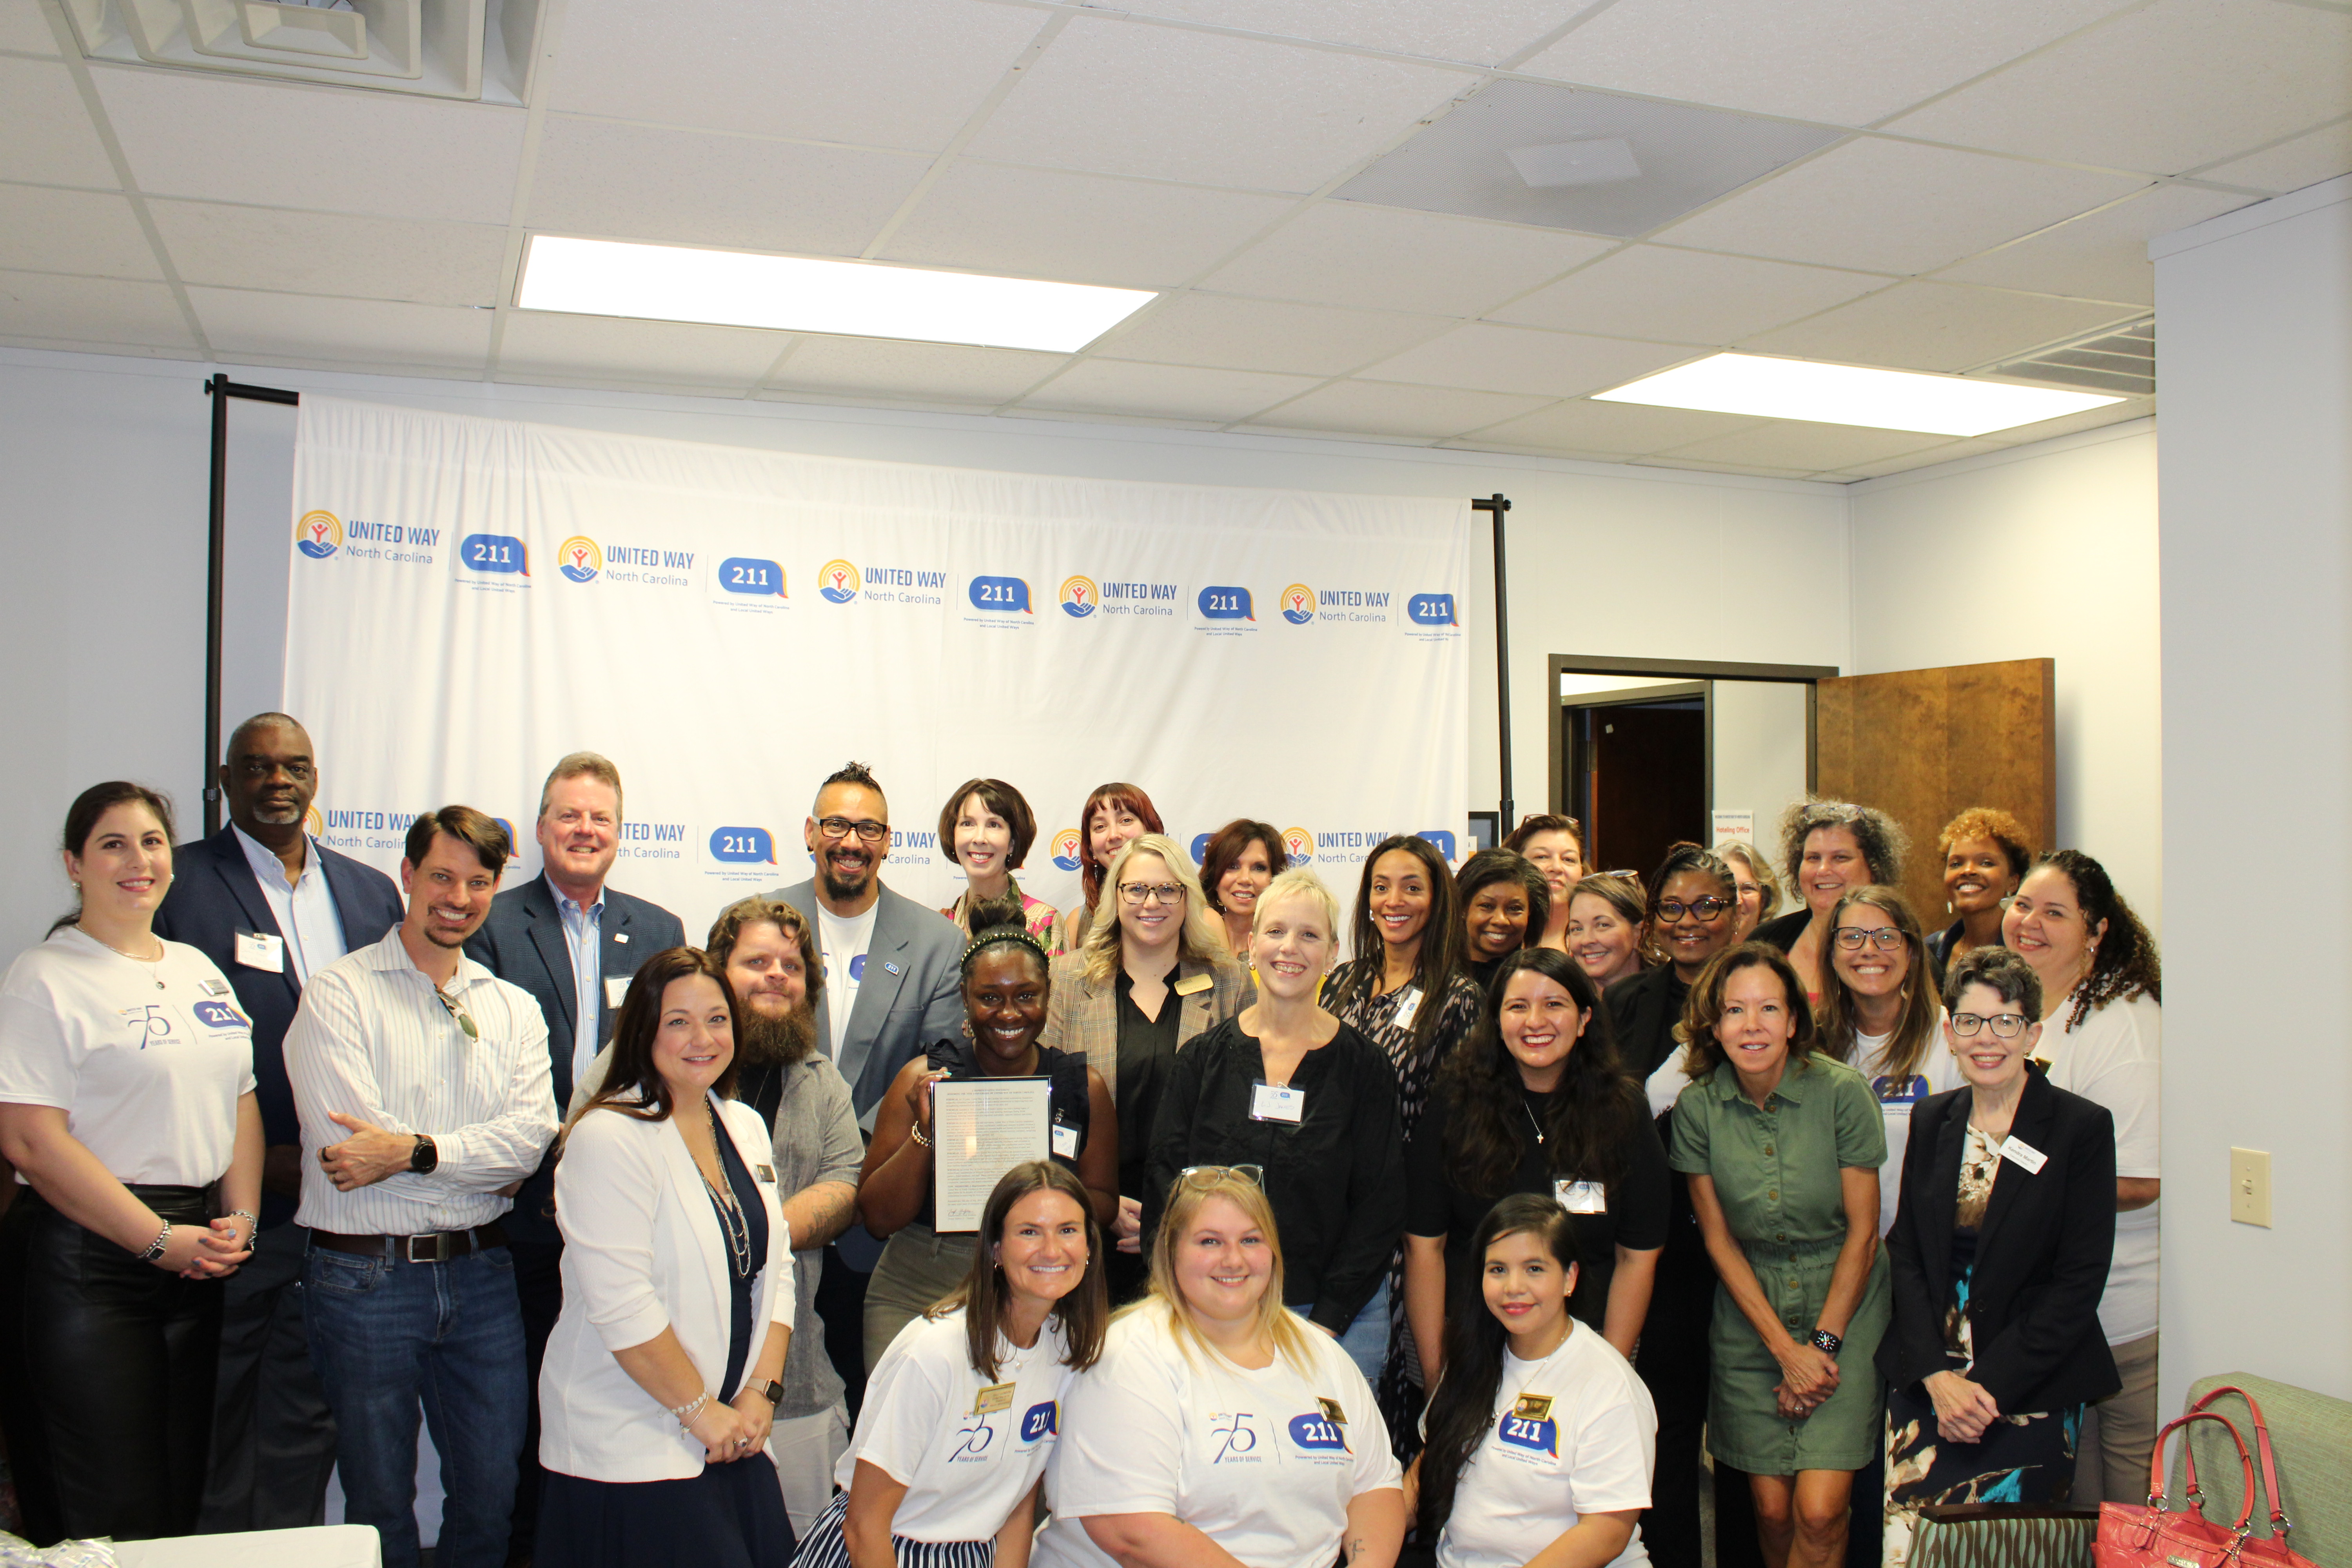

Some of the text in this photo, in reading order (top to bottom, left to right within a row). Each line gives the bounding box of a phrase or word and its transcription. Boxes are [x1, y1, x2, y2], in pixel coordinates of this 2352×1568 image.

[348, 520, 440, 546] UNITED WAY
[346, 545, 433, 564] North Carolina
[473, 543, 511, 563] 211
[607, 545, 695, 570] UNITED WAY
[606, 569, 688, 586] North Carolina
[732, 566, 768, 586] 211
[865, 567, 946, 588] UNITED WAY
[865, 590, 941, 605] North Carolina
[980, 584, 1014, 603] 211
[1103, 582, 1177, 601] UNITED WAY
[1319, 590, 1390, 607] UNITED WAY
[1103, 604, 1172, 616] North Carolina
[1209, 595, 1238, 610] 211
[1419, 602, 1448, 617] 211
[1319, 612, 1386, 622] North Carolina
[328, 810, 383, 830] UNITED
[619, 823, 685, 841] ITED WAY
[907, 832, 935, 849] WAY
[1318, 833, 1362, 847] UNITED
[327, 835, 406, 849] North Carolin
[723, 836, 757, 853] 211
[634, 847, 680, 858] Carolina
[888, 854, 930, 865] Carolina
[1318, 853, 1346, 863] North
[205, 1007, 239, 1022] 211
[128, 1005, 171, 1050] 75
[2007, 1146, 2023, 1157] Kendra
[2023, 1155, 2036, 1165] Martin
[1211, 1413, 1256, 1464] 75
[1302, 1422, 1338, 1442] 211
[1507, 1419, 1541, 1442] 211
